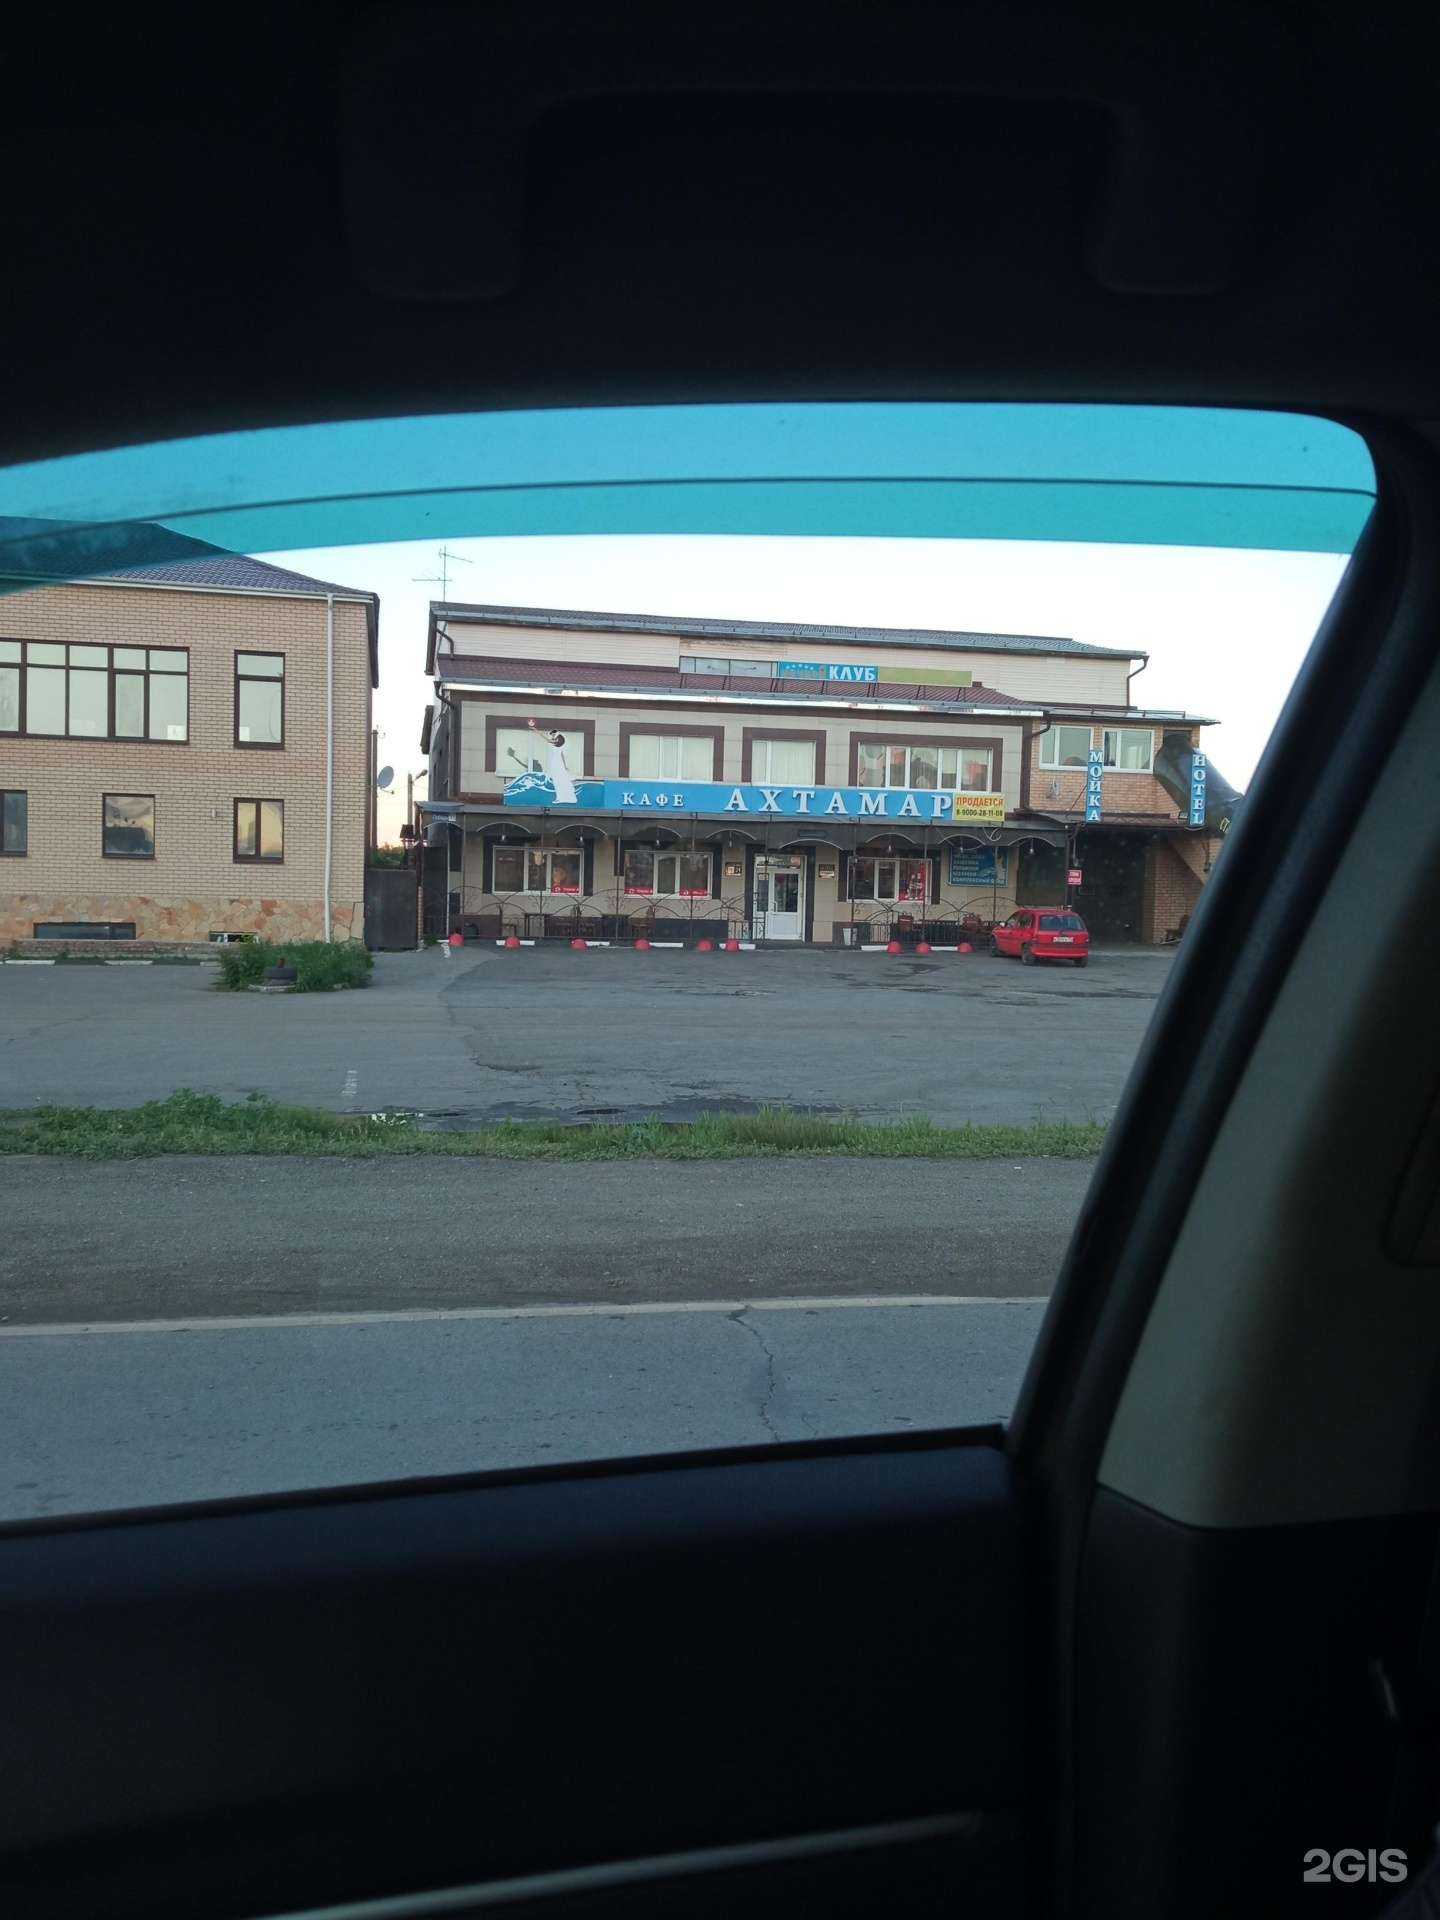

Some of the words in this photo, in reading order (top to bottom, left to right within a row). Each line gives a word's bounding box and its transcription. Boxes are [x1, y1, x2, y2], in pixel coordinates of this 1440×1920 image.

[829, 665, 876, 681] КЛУБ
[622, 792, 685, 807] КАФЕ
[724, 788, 951, 818] АХТАМАР
[1087, 751, 1103, 821] МОЙКА
[1190, 753, 1206, 826] HOTEL
